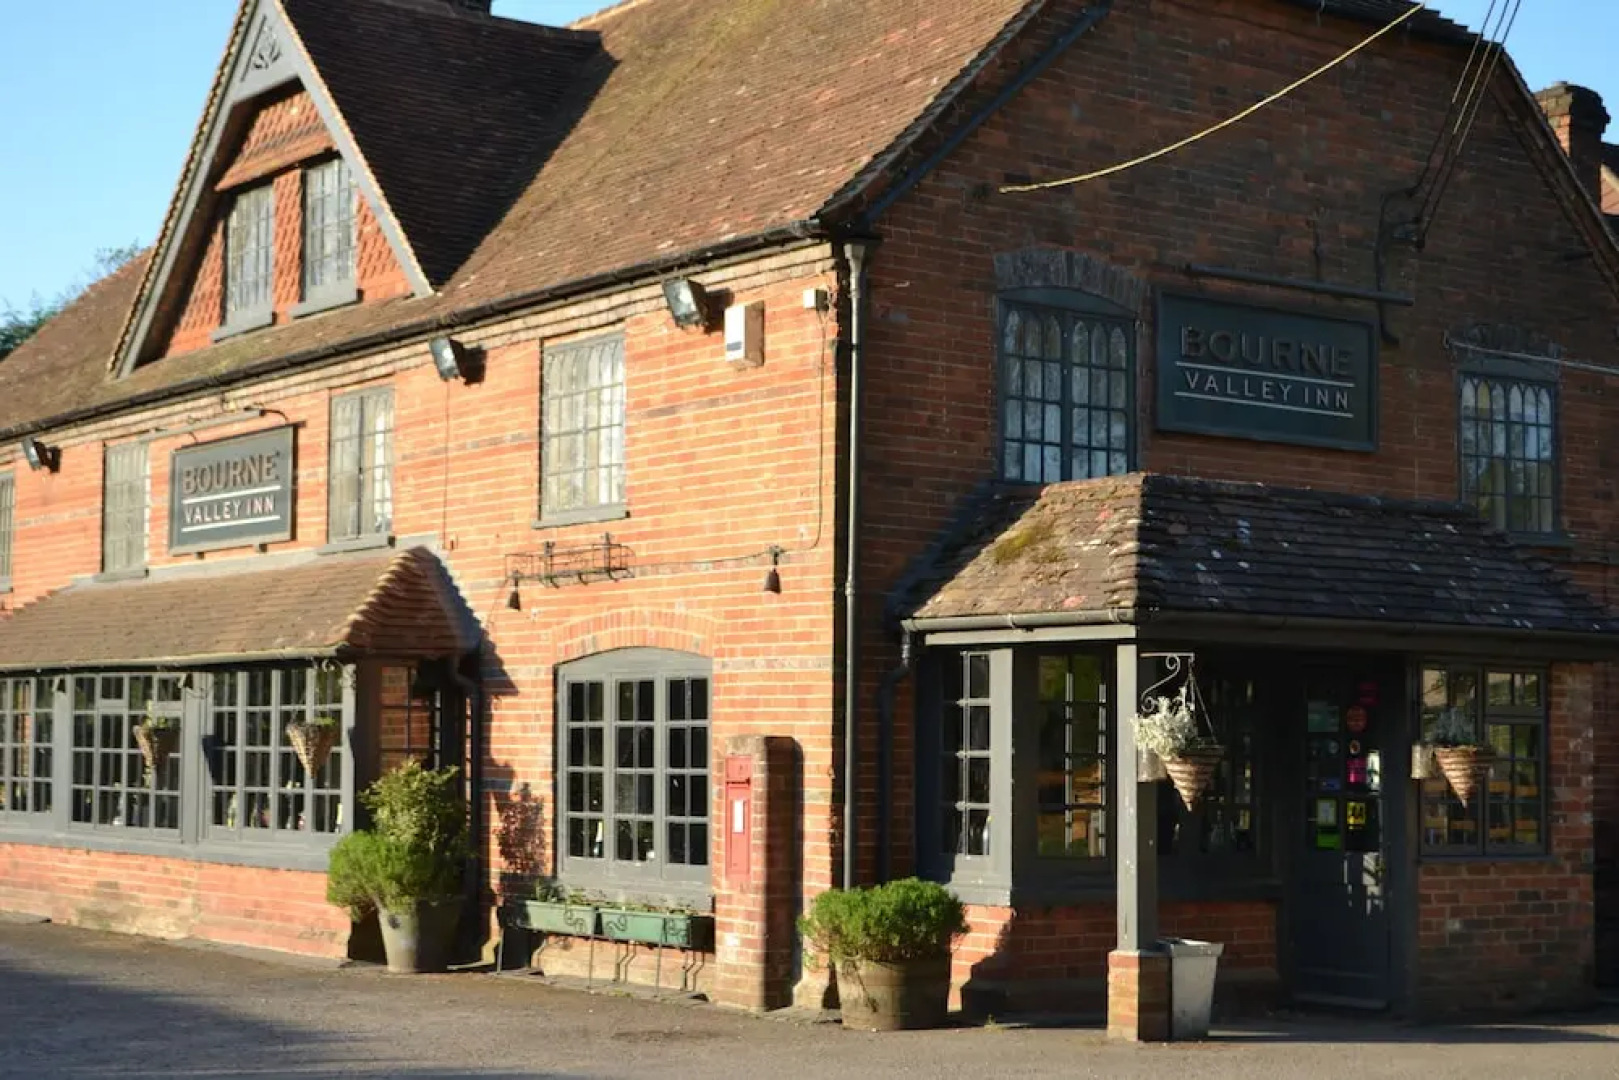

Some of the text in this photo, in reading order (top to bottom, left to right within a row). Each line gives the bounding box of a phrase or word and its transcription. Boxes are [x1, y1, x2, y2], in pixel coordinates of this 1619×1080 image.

[1180, 324, 1352, 377] BOURNE
[1184, 370, 1349, 409] VALLEY INN
[181, 452, 278, 495] BOURNE
[183, 494, 275, 524] VALLEY INN
